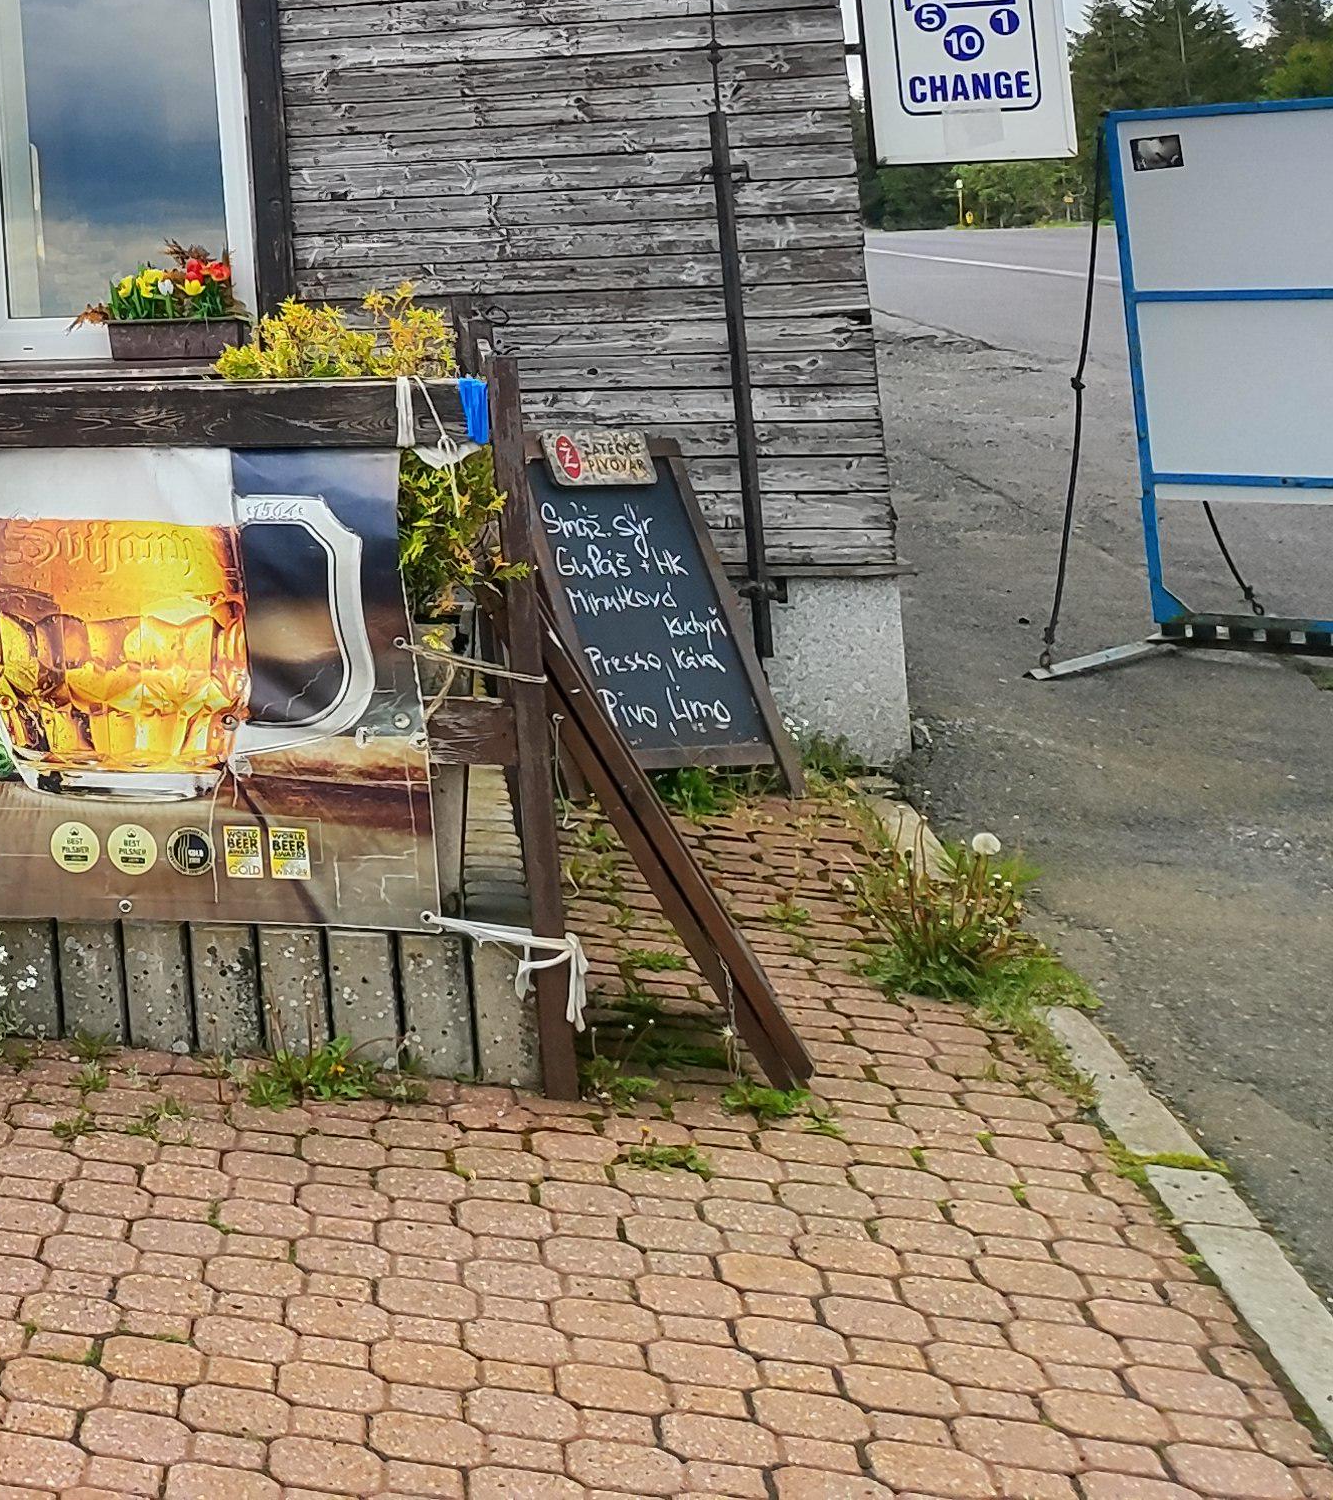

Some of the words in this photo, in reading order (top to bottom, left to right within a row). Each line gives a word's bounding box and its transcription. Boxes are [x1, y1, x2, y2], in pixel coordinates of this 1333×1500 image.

[919, 5, 941, 30] 5
[994, 10, 1011, 33] 1
[944, 31, 982, 56] 10
[908, 70, 1033, 105] CHANGE
[227, 838, 258, 849] BEER
[272, 840, 305, 852] BEER
[229, 865, 261, 876] GOLD
